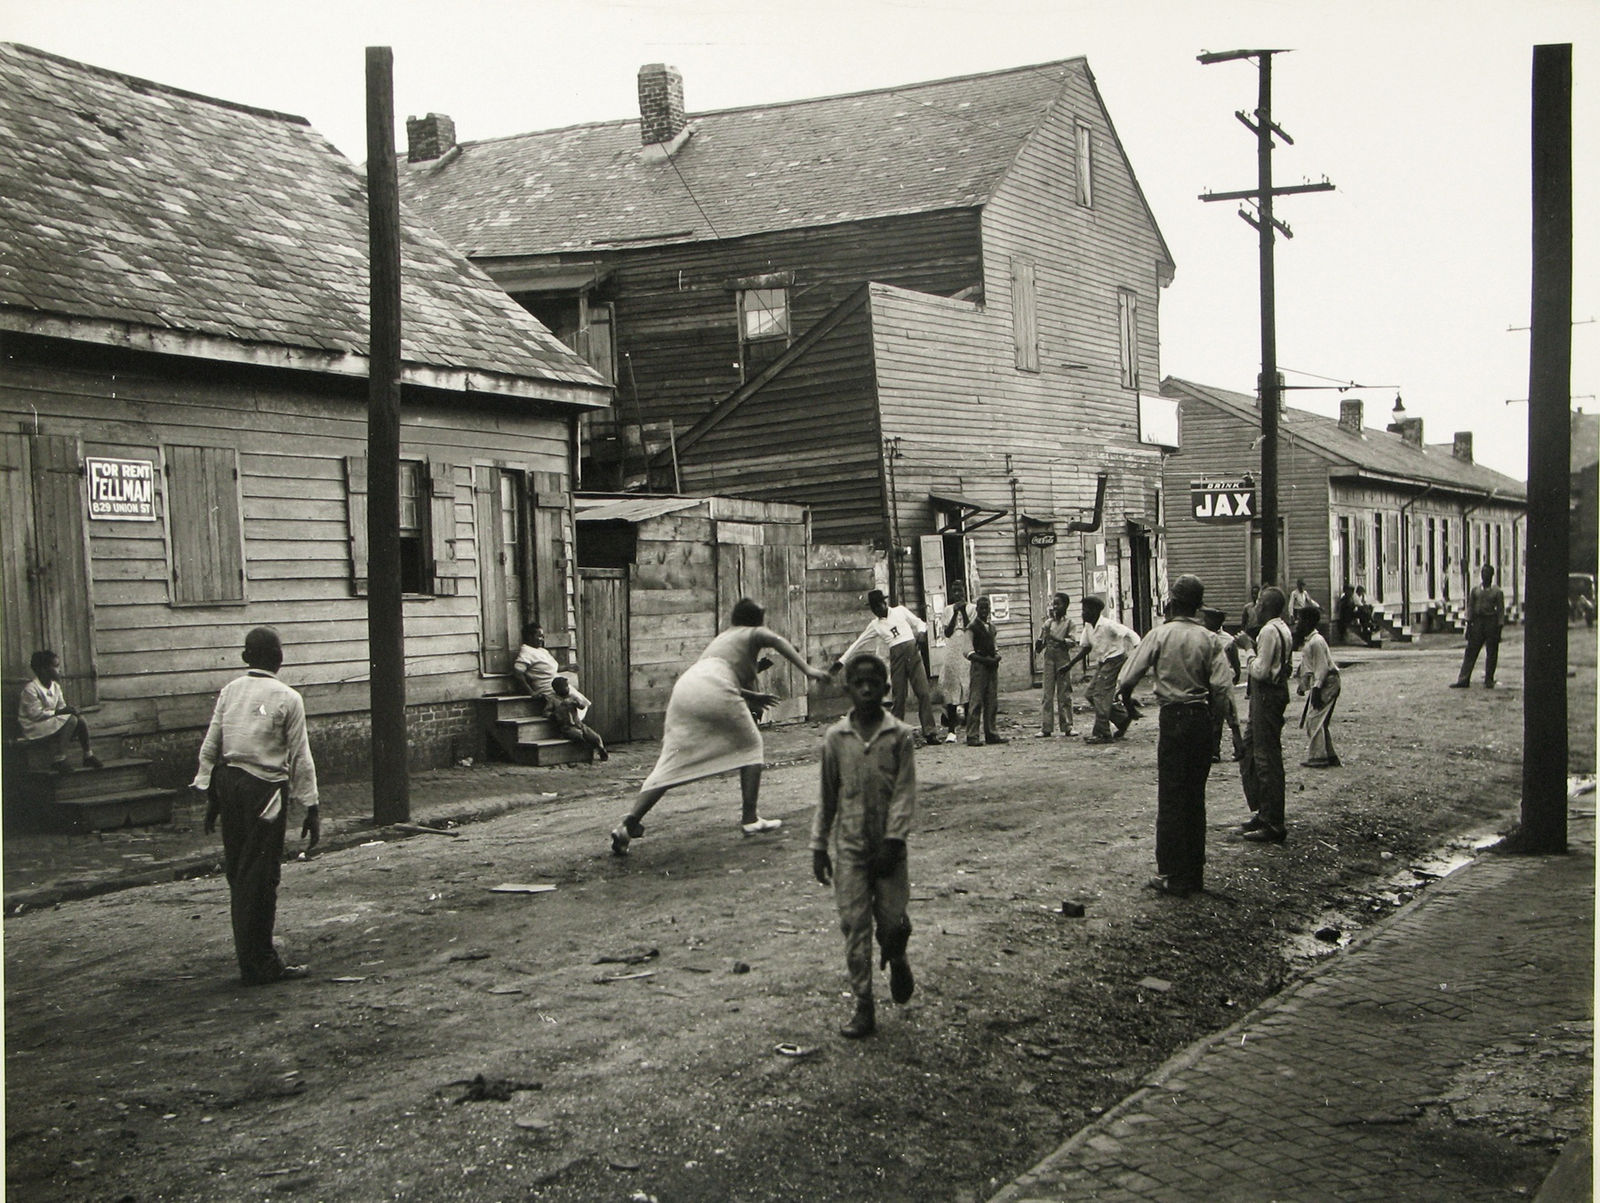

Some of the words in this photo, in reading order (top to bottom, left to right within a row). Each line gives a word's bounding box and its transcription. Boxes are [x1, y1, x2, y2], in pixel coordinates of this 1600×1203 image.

[91, 462, 119, 479] FOR
[121, 464, 150, 478] RENT
[91, 474, 151, 502] FELLMAN
[92, 502, 112, 513] 829
[112, 503, 139, 513] UNION
[140, 504, 151, 514] ST
[1196, 493, 1251, 517] JAX
